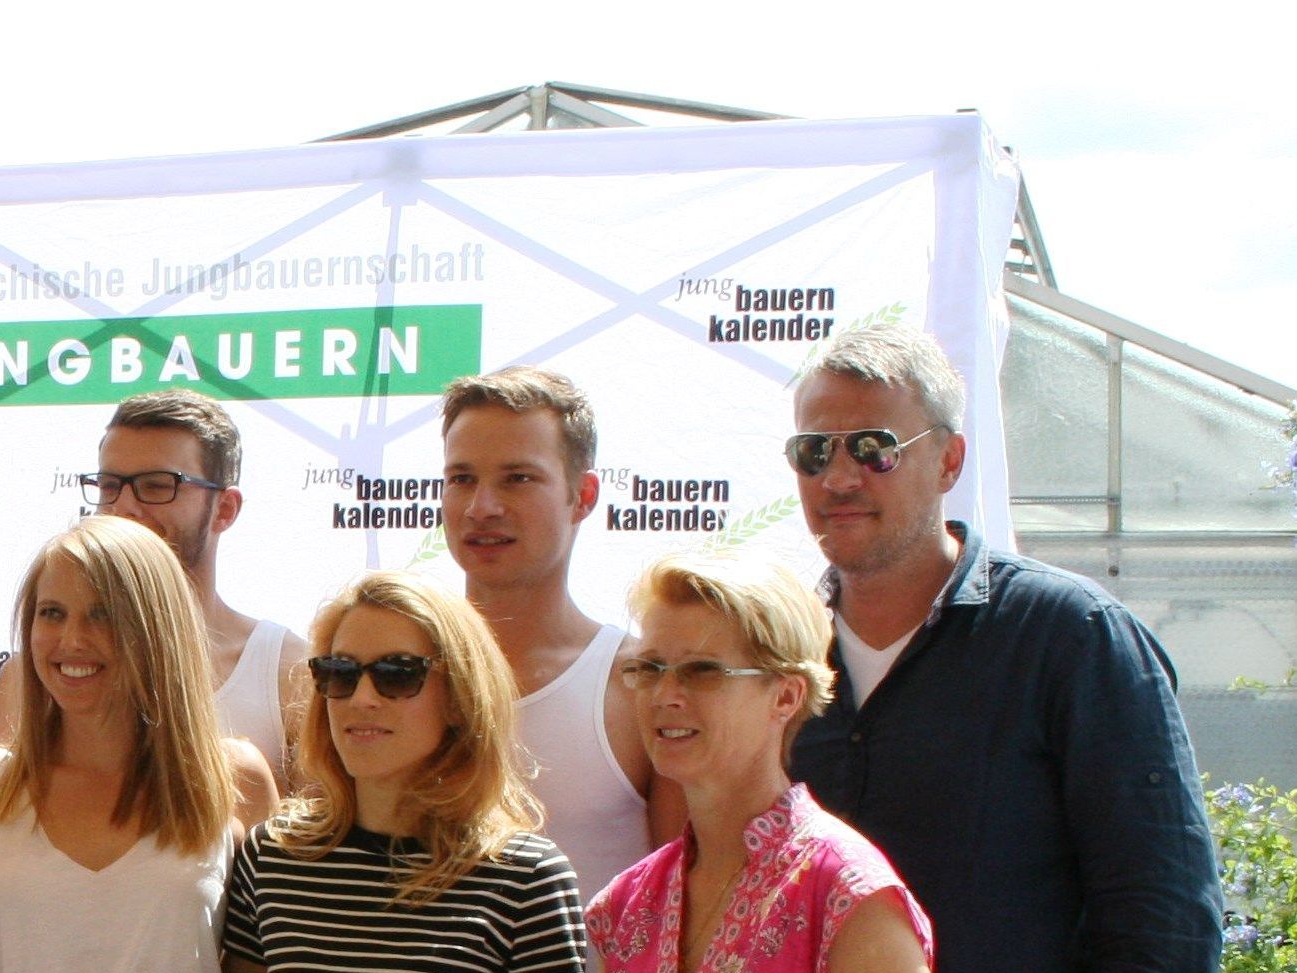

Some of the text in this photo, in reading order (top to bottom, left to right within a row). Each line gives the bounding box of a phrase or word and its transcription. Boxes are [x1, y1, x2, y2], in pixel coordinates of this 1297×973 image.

[142, 243, 485, 300] Jungbauernschaft
[675, 272, 834, 312] jung bauern
[709, 313, 834, 342] kalender
[302, 463, 444, 501] jung bauern
[632, 474, 730, 502] bauern
